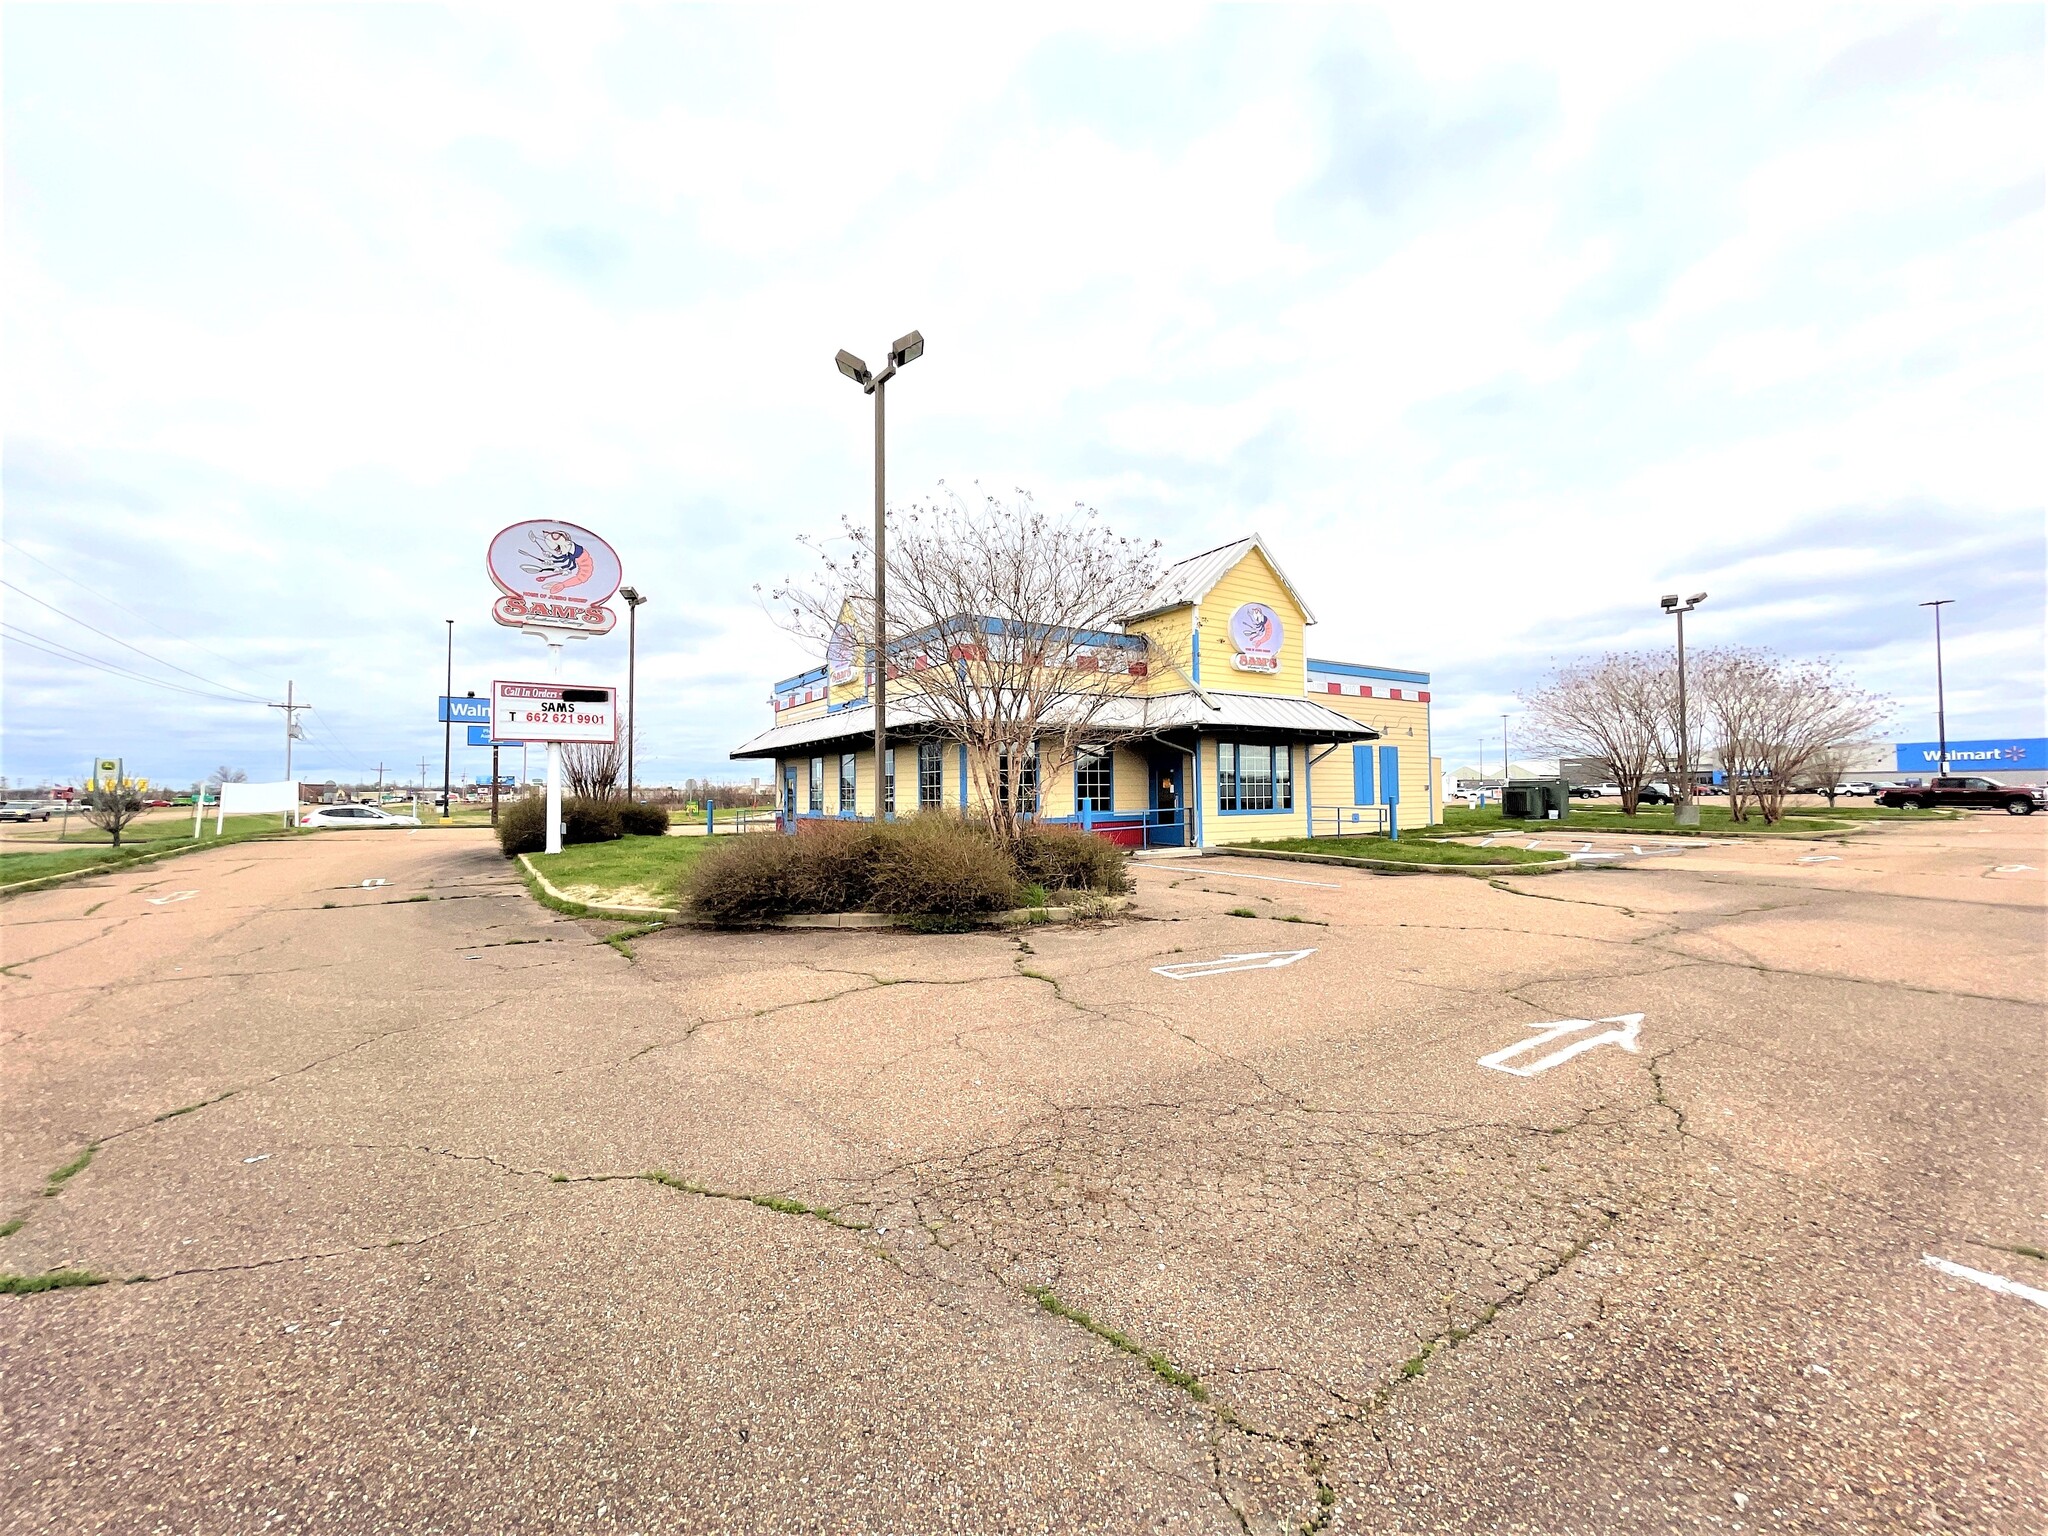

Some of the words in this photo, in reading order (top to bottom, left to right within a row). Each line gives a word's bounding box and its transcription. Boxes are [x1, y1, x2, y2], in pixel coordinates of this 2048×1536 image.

[503, 598, 606, 624] SAM'S
[504, 687, 520, 697] Call
[521, 688, 531, 697] In
[532, 688, 557, 698] Orders
[541, 702, 575, 713] SAMS
[509, 711, 516, 721] T
[526, 712, 549, 723] 662
[552, 713, 574, 724] 621
[577, 714, 604, 725] 9901
[1923, 748, 2002, 762] Walmart
